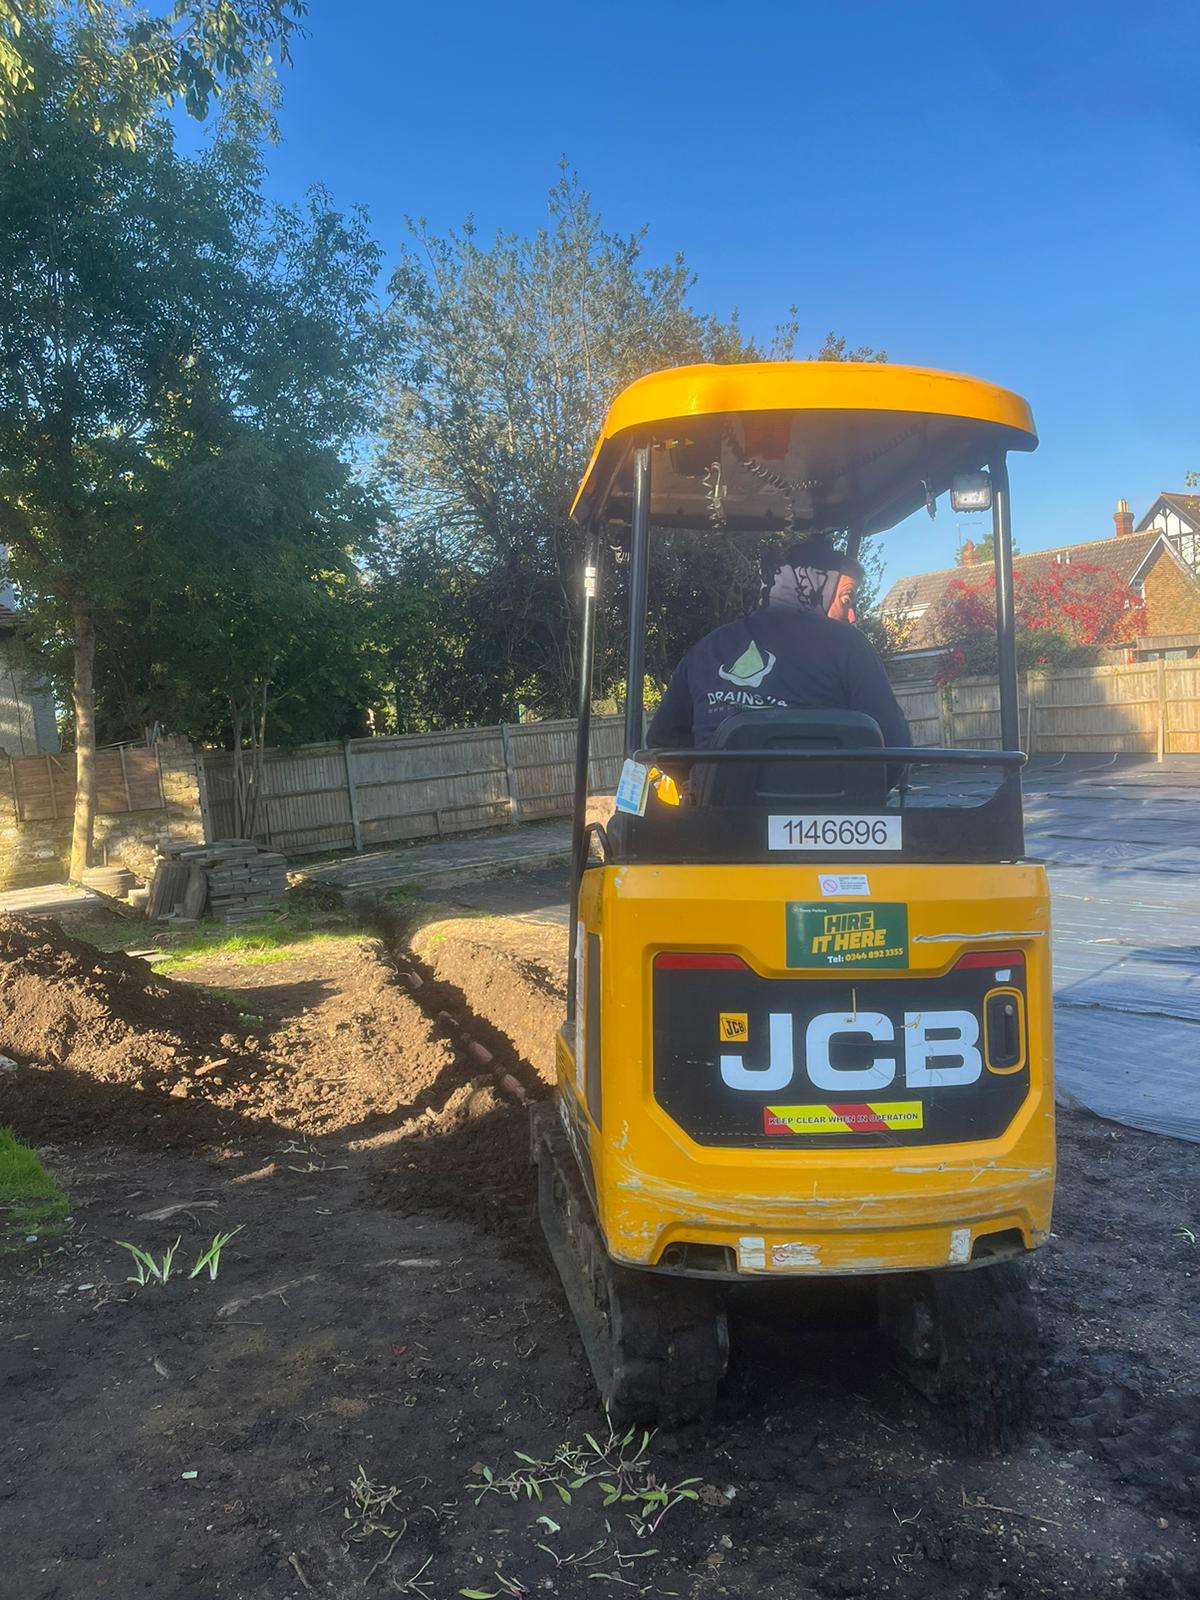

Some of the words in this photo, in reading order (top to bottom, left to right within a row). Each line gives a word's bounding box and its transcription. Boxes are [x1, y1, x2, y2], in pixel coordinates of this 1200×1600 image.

[783, 820, 888, 845] 1146696
[825, 911, 873, 934] HIRE
[811, 935, 832, 954] IT
[834, 930, 887, 951] HERE
[827, 955, 845, 964] Tel:
[726, 1020, 745, 1036] JCB
[720, 1010, 983, 1092] JCB
[768, 1117, 793, 1125] KEEP
[796, 1116, 826, 1124] CLEAR
[828, 1115, 855, 1123] WHEN
[857, 1115, 869, 1123] IN
[871, 1113, 918, 1122] OPERATION
